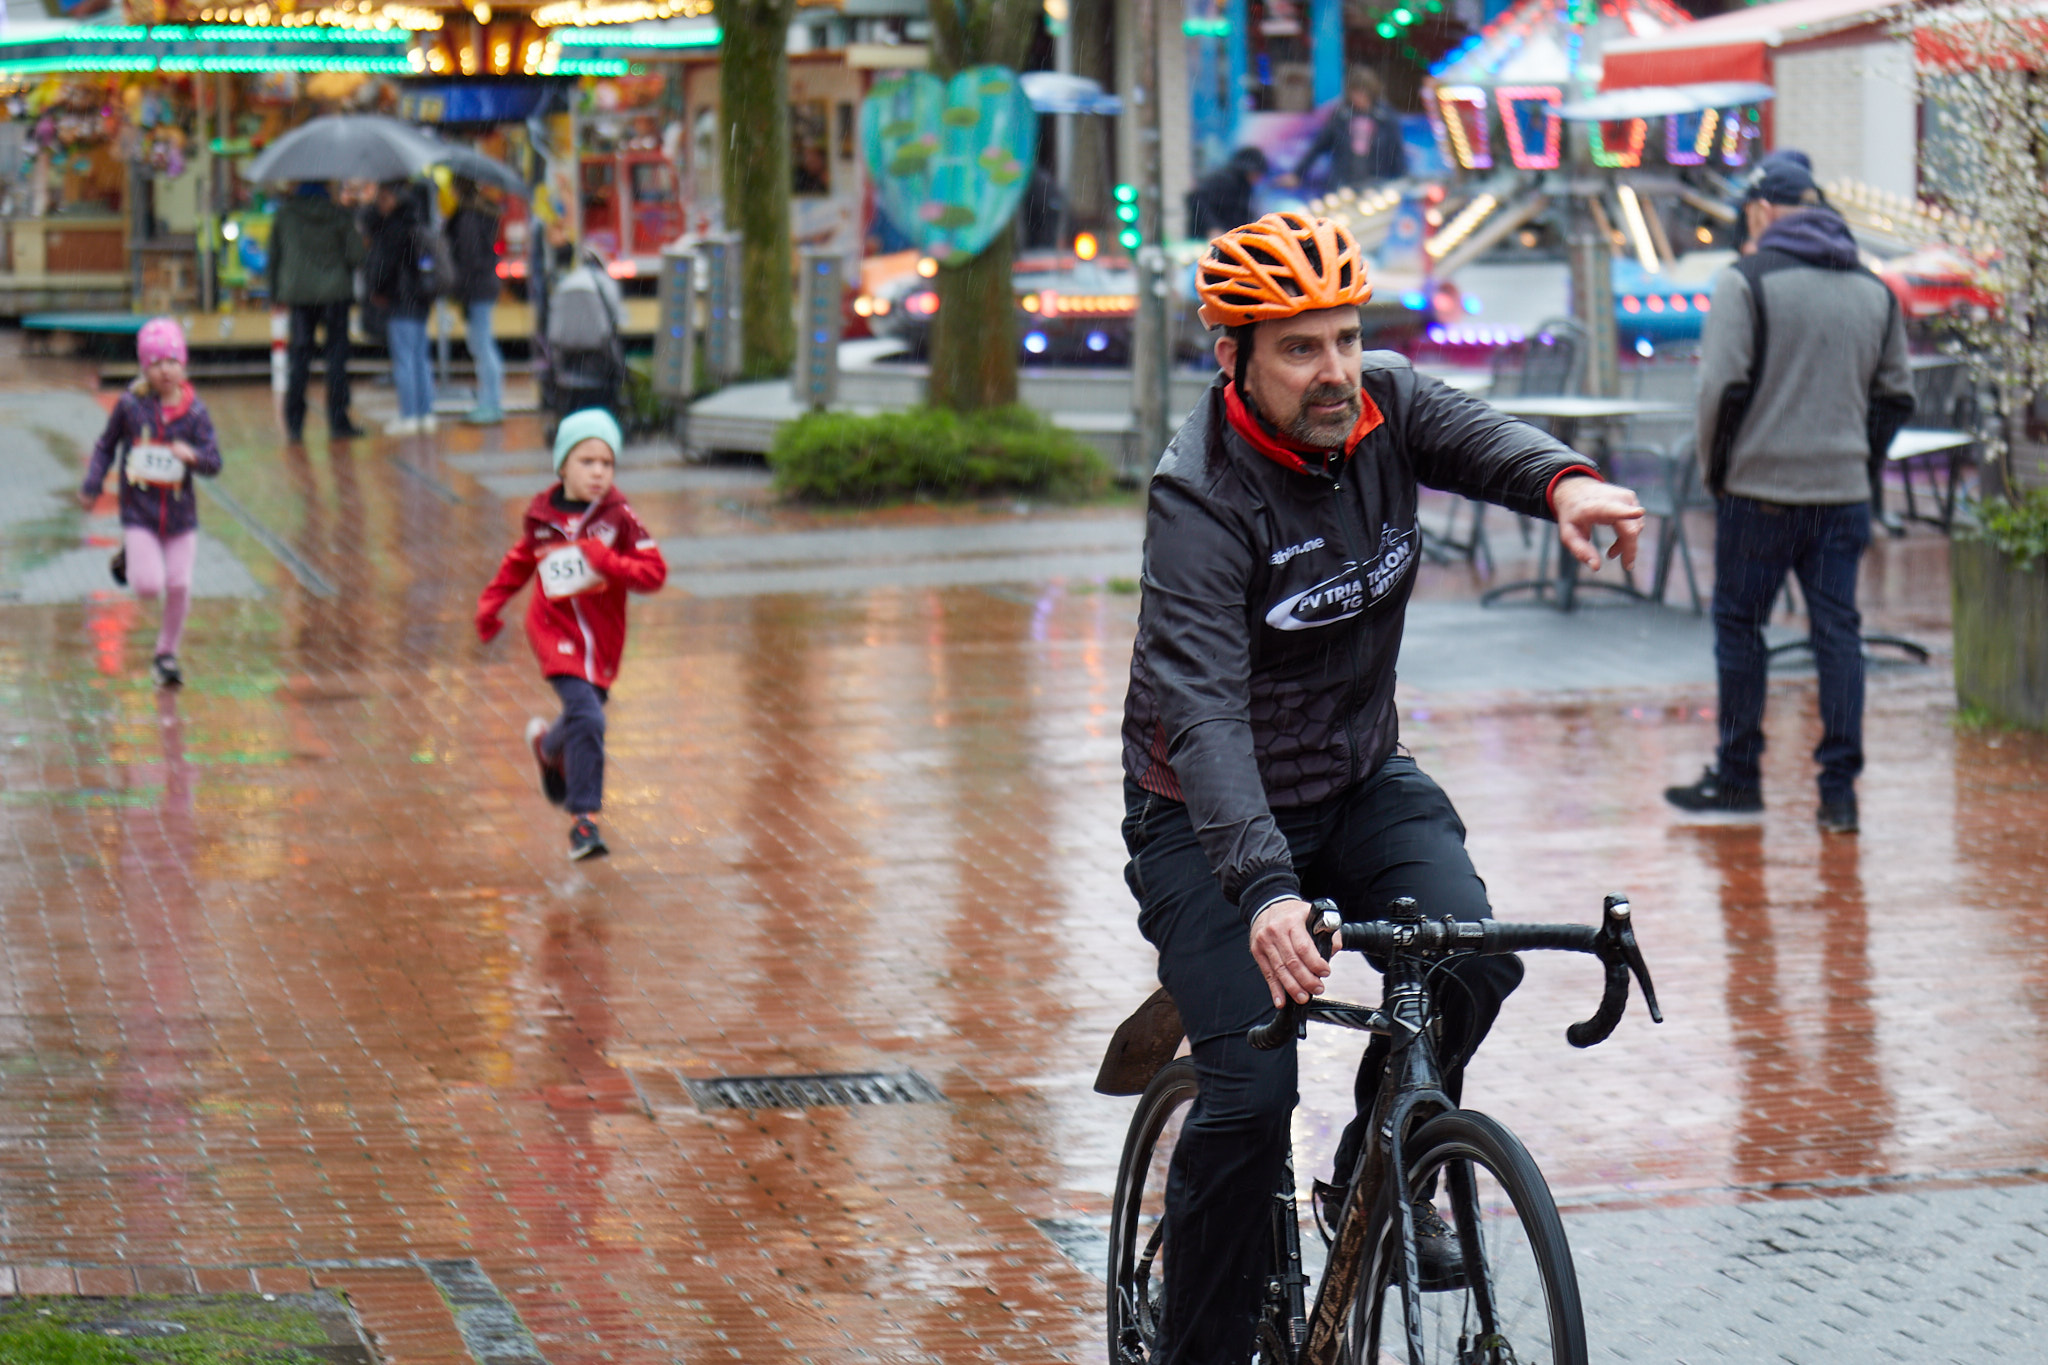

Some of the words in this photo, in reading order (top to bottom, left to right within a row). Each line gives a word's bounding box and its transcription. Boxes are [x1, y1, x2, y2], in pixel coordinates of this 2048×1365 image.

[549, 557, 586, 581] 551
[1298, 593, 1323, 612] PV
[1341, 595, 1363, 612] TG
[1398, 1200, 1425, 1365] RIDLEY
